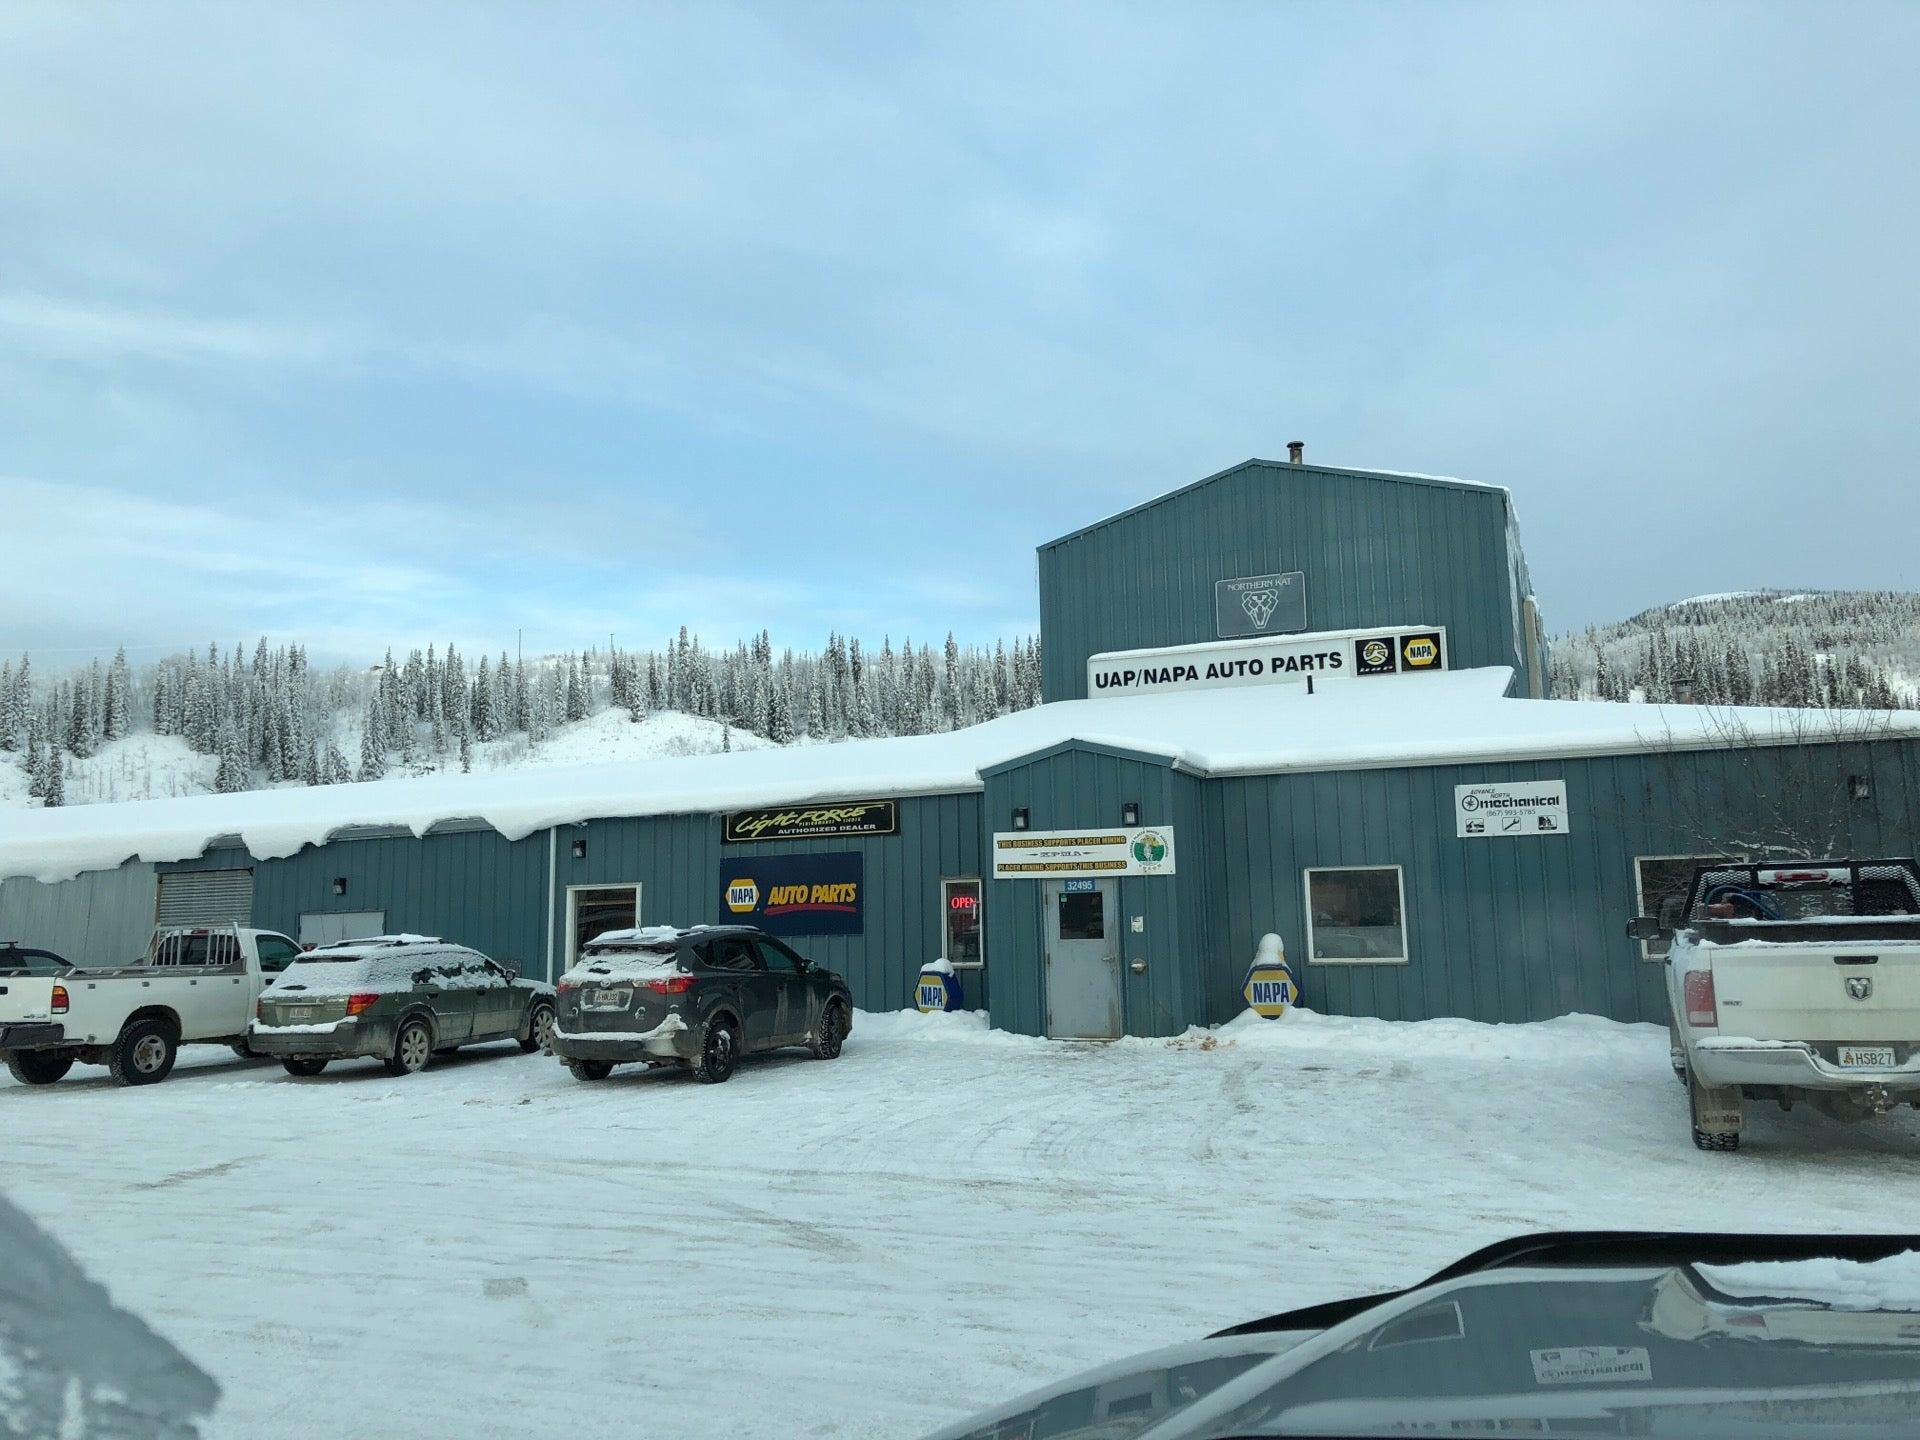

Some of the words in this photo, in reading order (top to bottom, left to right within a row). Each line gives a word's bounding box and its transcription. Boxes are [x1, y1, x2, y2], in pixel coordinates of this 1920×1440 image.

[1227, 580, 1273, 591] NORTHERN
[1275, 577, 1292, 586] KAT
[1409, 645, 1433, 659] NAPA
[1095, 665, 1199, 689] UAP/NAPA
[1206, 659, 1264, 680] AUTO
[1271, 651, 1343, 674] PARTS
[1480, 795, 1560, 809] mechanical
[778, 826, 837, 835] AUTHORIZED
[997, 840, 1012, 849] THIS
[1012, 838, 1043, 848] BUSINESS
[1043, 837, 1077, 847] SUPPORTS
[1077, 836, 1101, 846] PLACER
[1101, 835, 1126, 845] MINING
[997, 863, 1021, 872] PLACER
[1021, 863, 1045, 871] MINING
[1045, 862, 1078, 871] SUPPORTS
[1078, 861, 1094, 870] THIS
[1094, 860, 1127, 869] BUSINESS
[1067, 880, 1093, 891] 32495
[731, 888, 754, 904] NAPA
[768, 885, 808, 905] AUTO
[810, 883, 857, 904] PARTS
[951, 896, 977, 909] OPEN
[921, 986, 943, 1006] NAPA
[1253, 982, 1289, 1003] NAPA
[1855, 1052, 1892, 1065] HSB27
